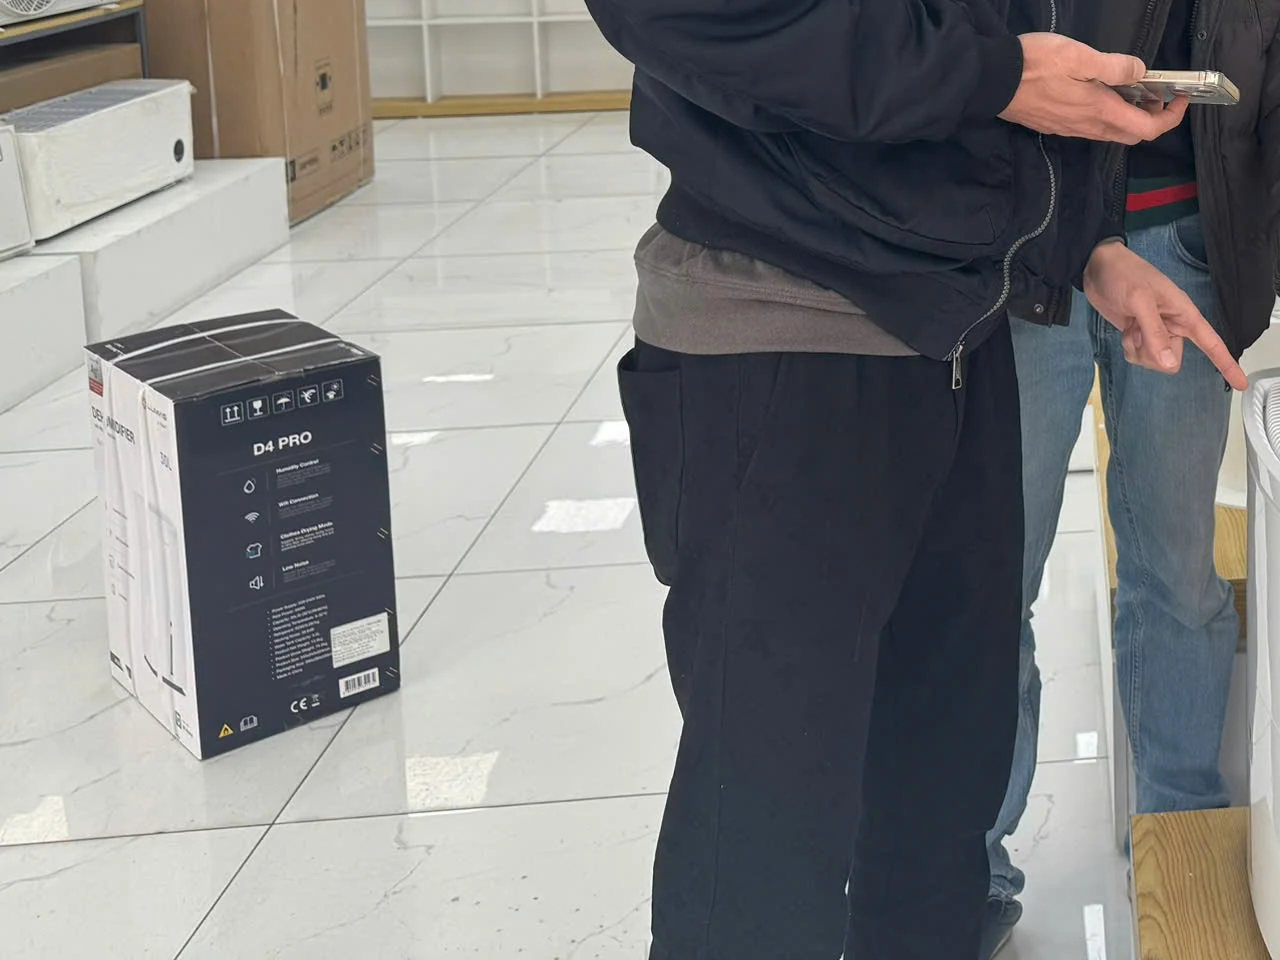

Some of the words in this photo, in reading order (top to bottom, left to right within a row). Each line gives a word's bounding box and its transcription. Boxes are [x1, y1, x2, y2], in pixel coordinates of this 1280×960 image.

[252, 438, 274, 456] D4
[278, 430, 312, 450] PRO
[300, 458, 320, 468] Control
[290, 493, 320, 505] Connection
[318, 520, 334, 530] Mode
